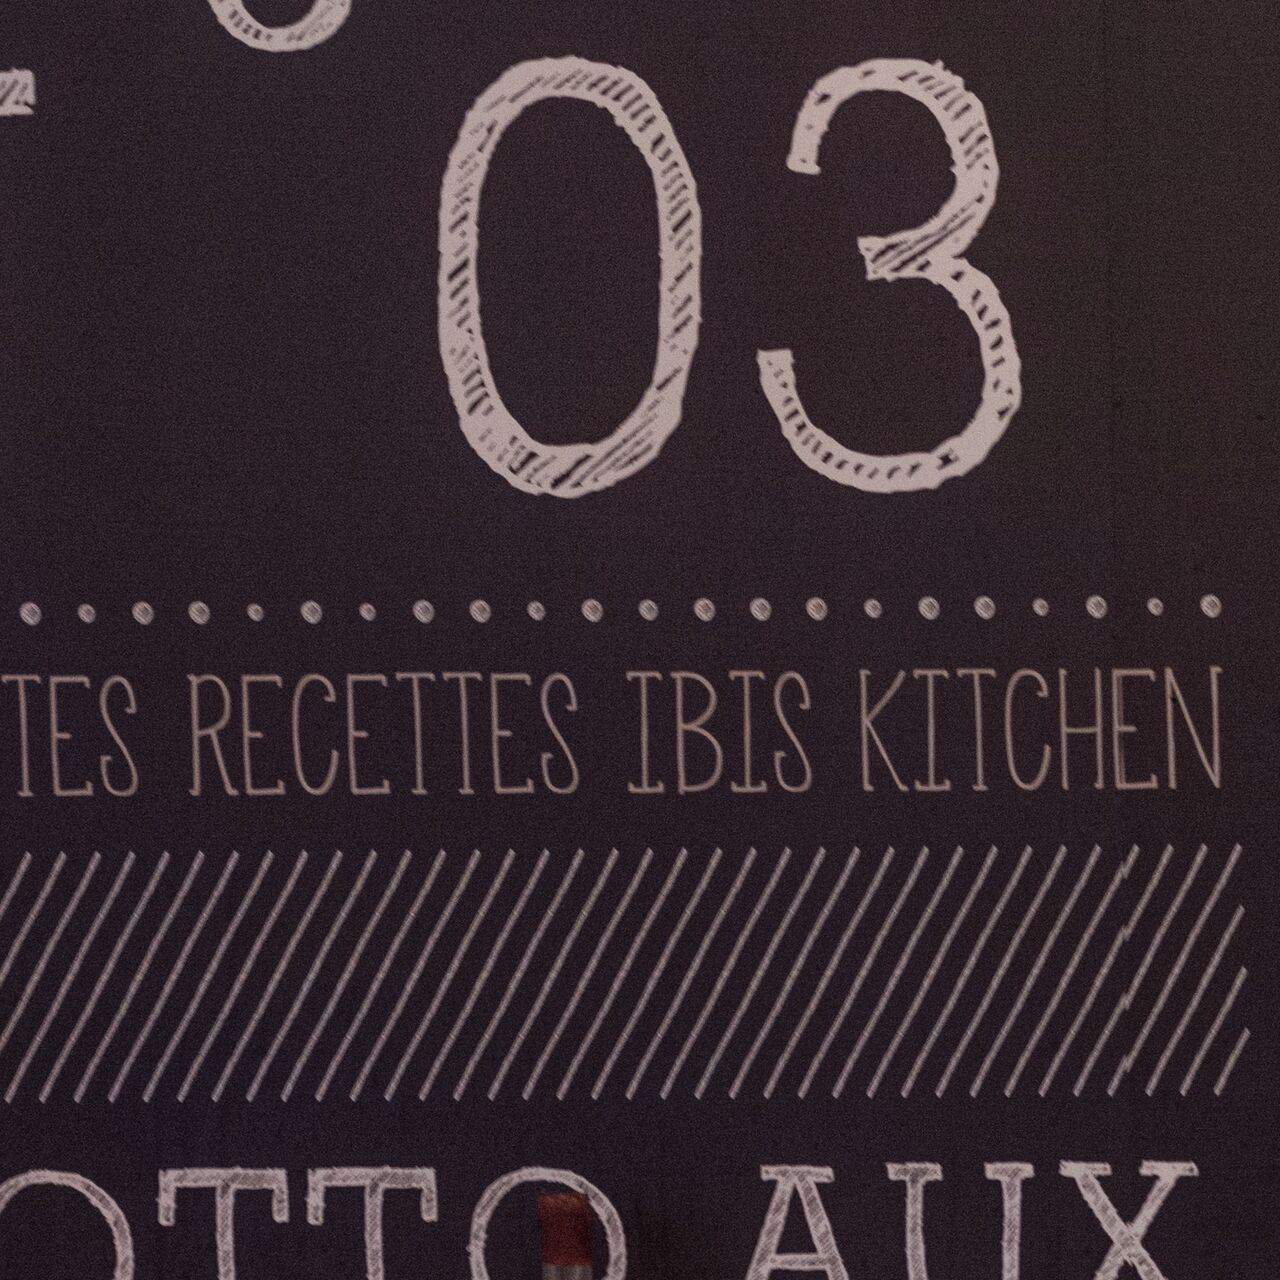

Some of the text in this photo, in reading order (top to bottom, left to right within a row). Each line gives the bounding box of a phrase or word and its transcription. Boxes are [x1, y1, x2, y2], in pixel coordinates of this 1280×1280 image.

[437, 55, 1022, 499] 03
[189, 673, 578, 795] RECETTES
[627, 671, 811, 793] IBIS
[860, 667, 1221, 791] KITCHEN
